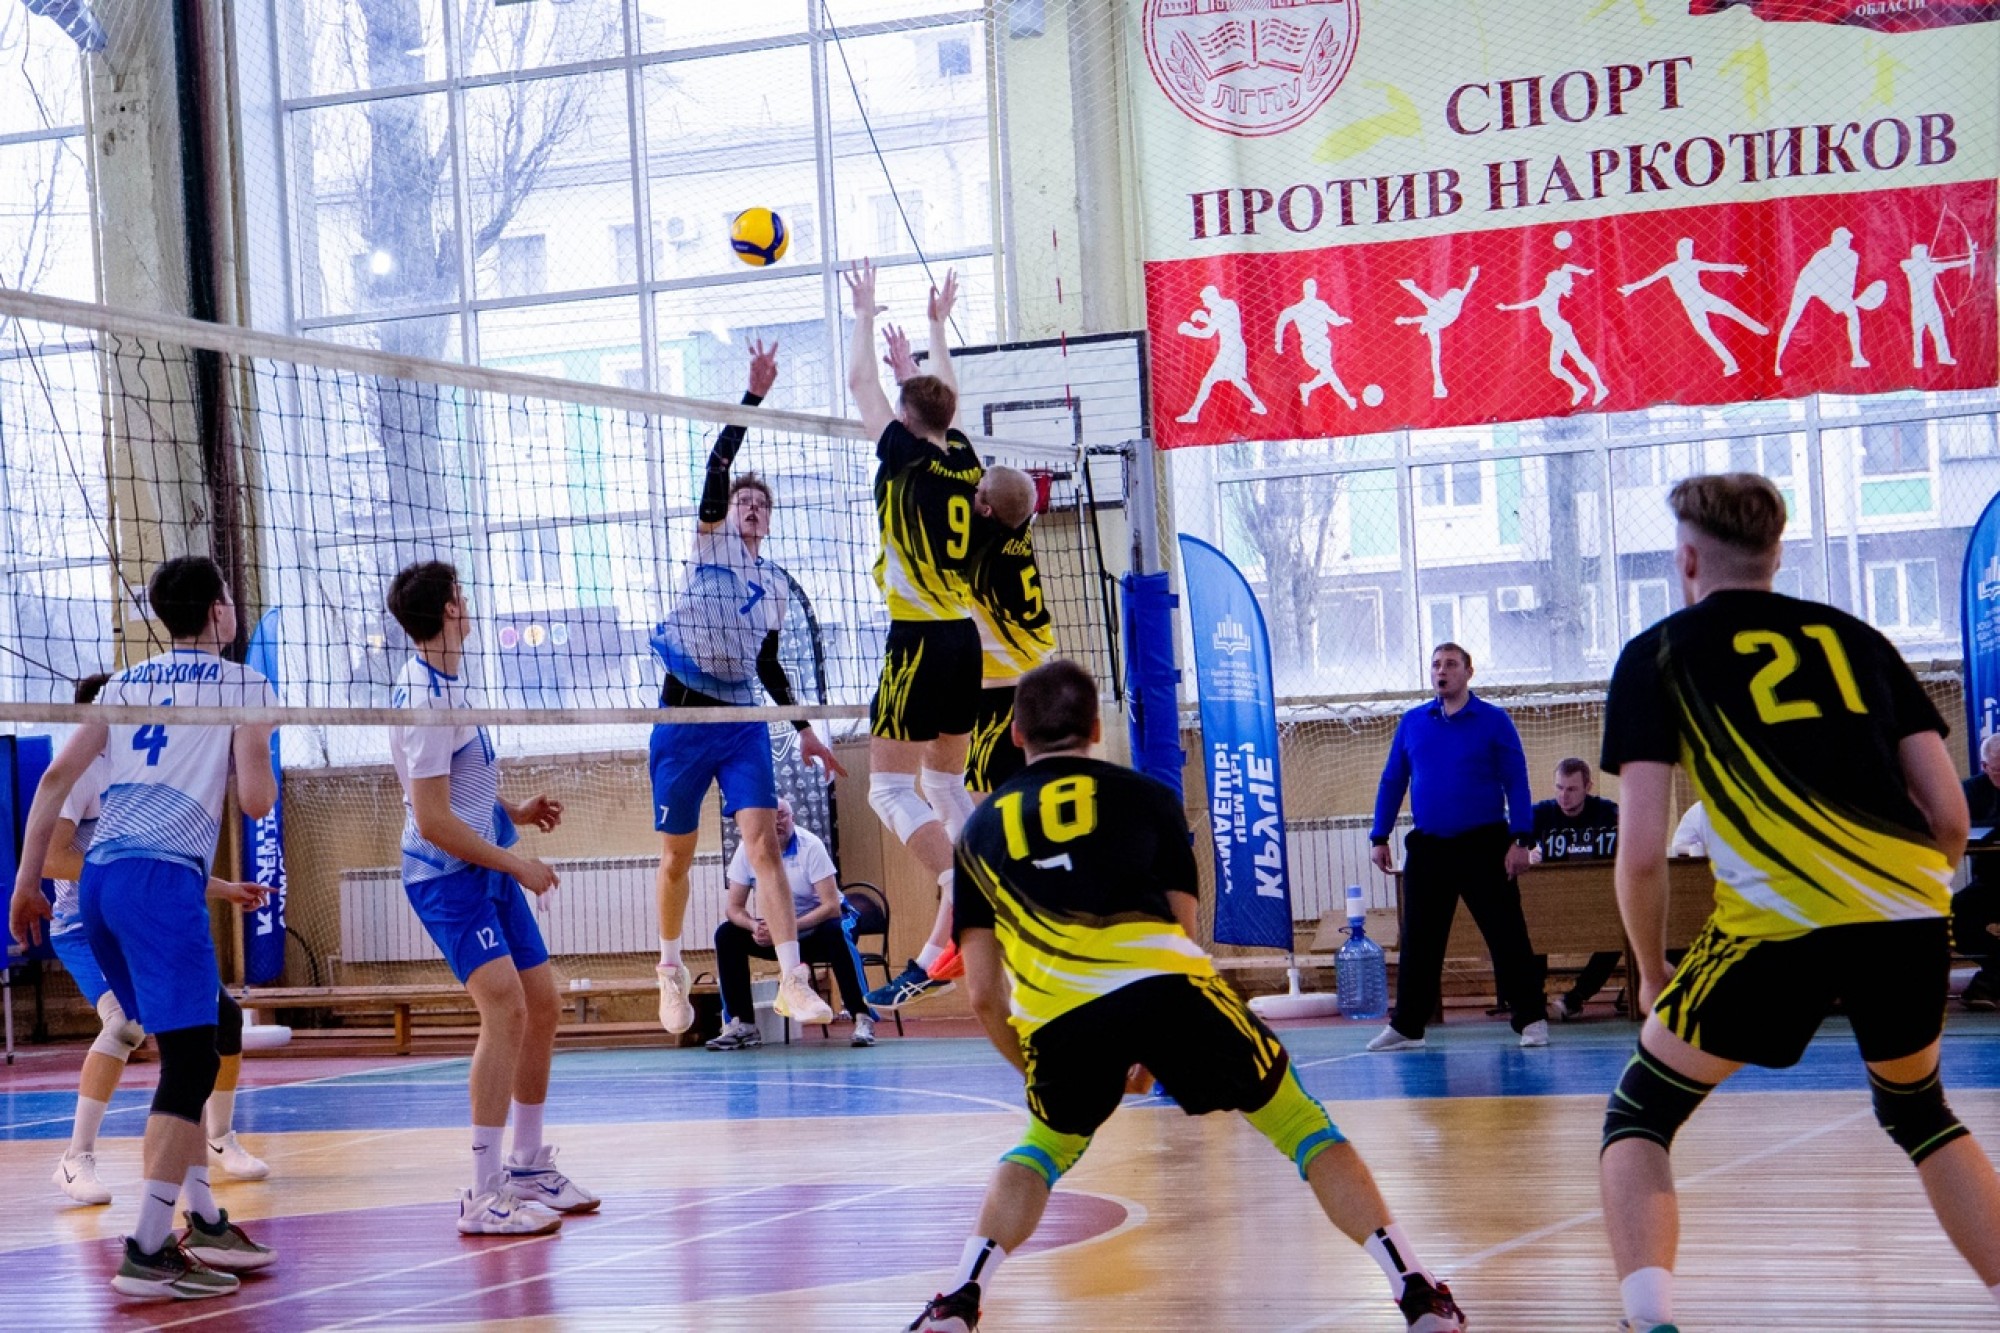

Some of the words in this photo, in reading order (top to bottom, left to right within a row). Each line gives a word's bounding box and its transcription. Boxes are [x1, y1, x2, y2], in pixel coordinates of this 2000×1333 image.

[1855, 0, 1927, 16] ОБЛАСТИ
[1211, 77, 1300, 114] ЛГПУ
[1446, 55, 1693, 135] СПОРТ
[1187, 168, 1464, 240] ПРОТИВ
[1482, 112, 1958, 212] НАРКОТИКОВ
[946, 494, 970, 559] 9
[1020, 565, 1043, 620] 5
[1732, 624, 1869, 725] 21
[132, 697, 172, 767] 4
[659, 804, 670, 825] 7
[994, 774, 1098, 861] 18
[1545, 834, 1567, 857] 19
[1595, 832, 1617, 855] 17
[475, 926, 499, 950] 12
